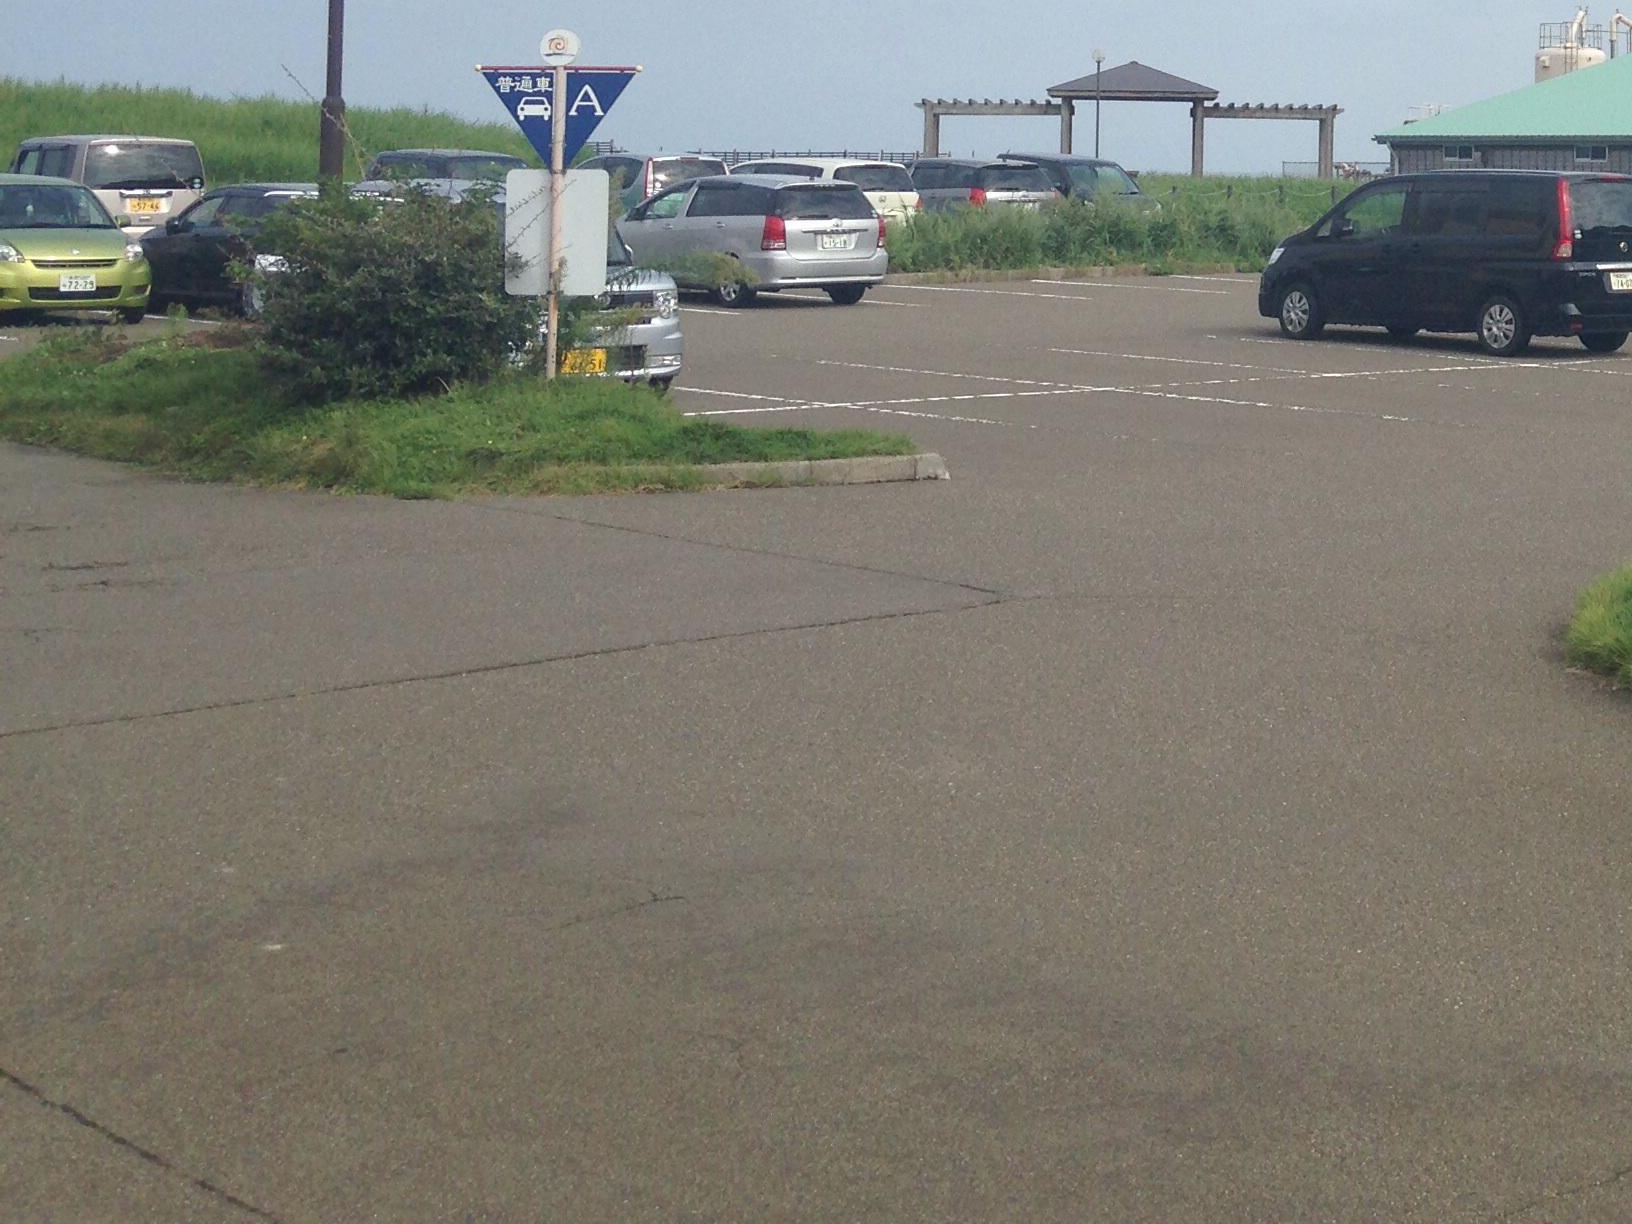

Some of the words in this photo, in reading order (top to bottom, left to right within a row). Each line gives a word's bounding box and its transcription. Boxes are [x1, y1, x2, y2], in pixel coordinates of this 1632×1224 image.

[495, 76, 553, 93] 普通車
[568, 84, 605, 116] A
